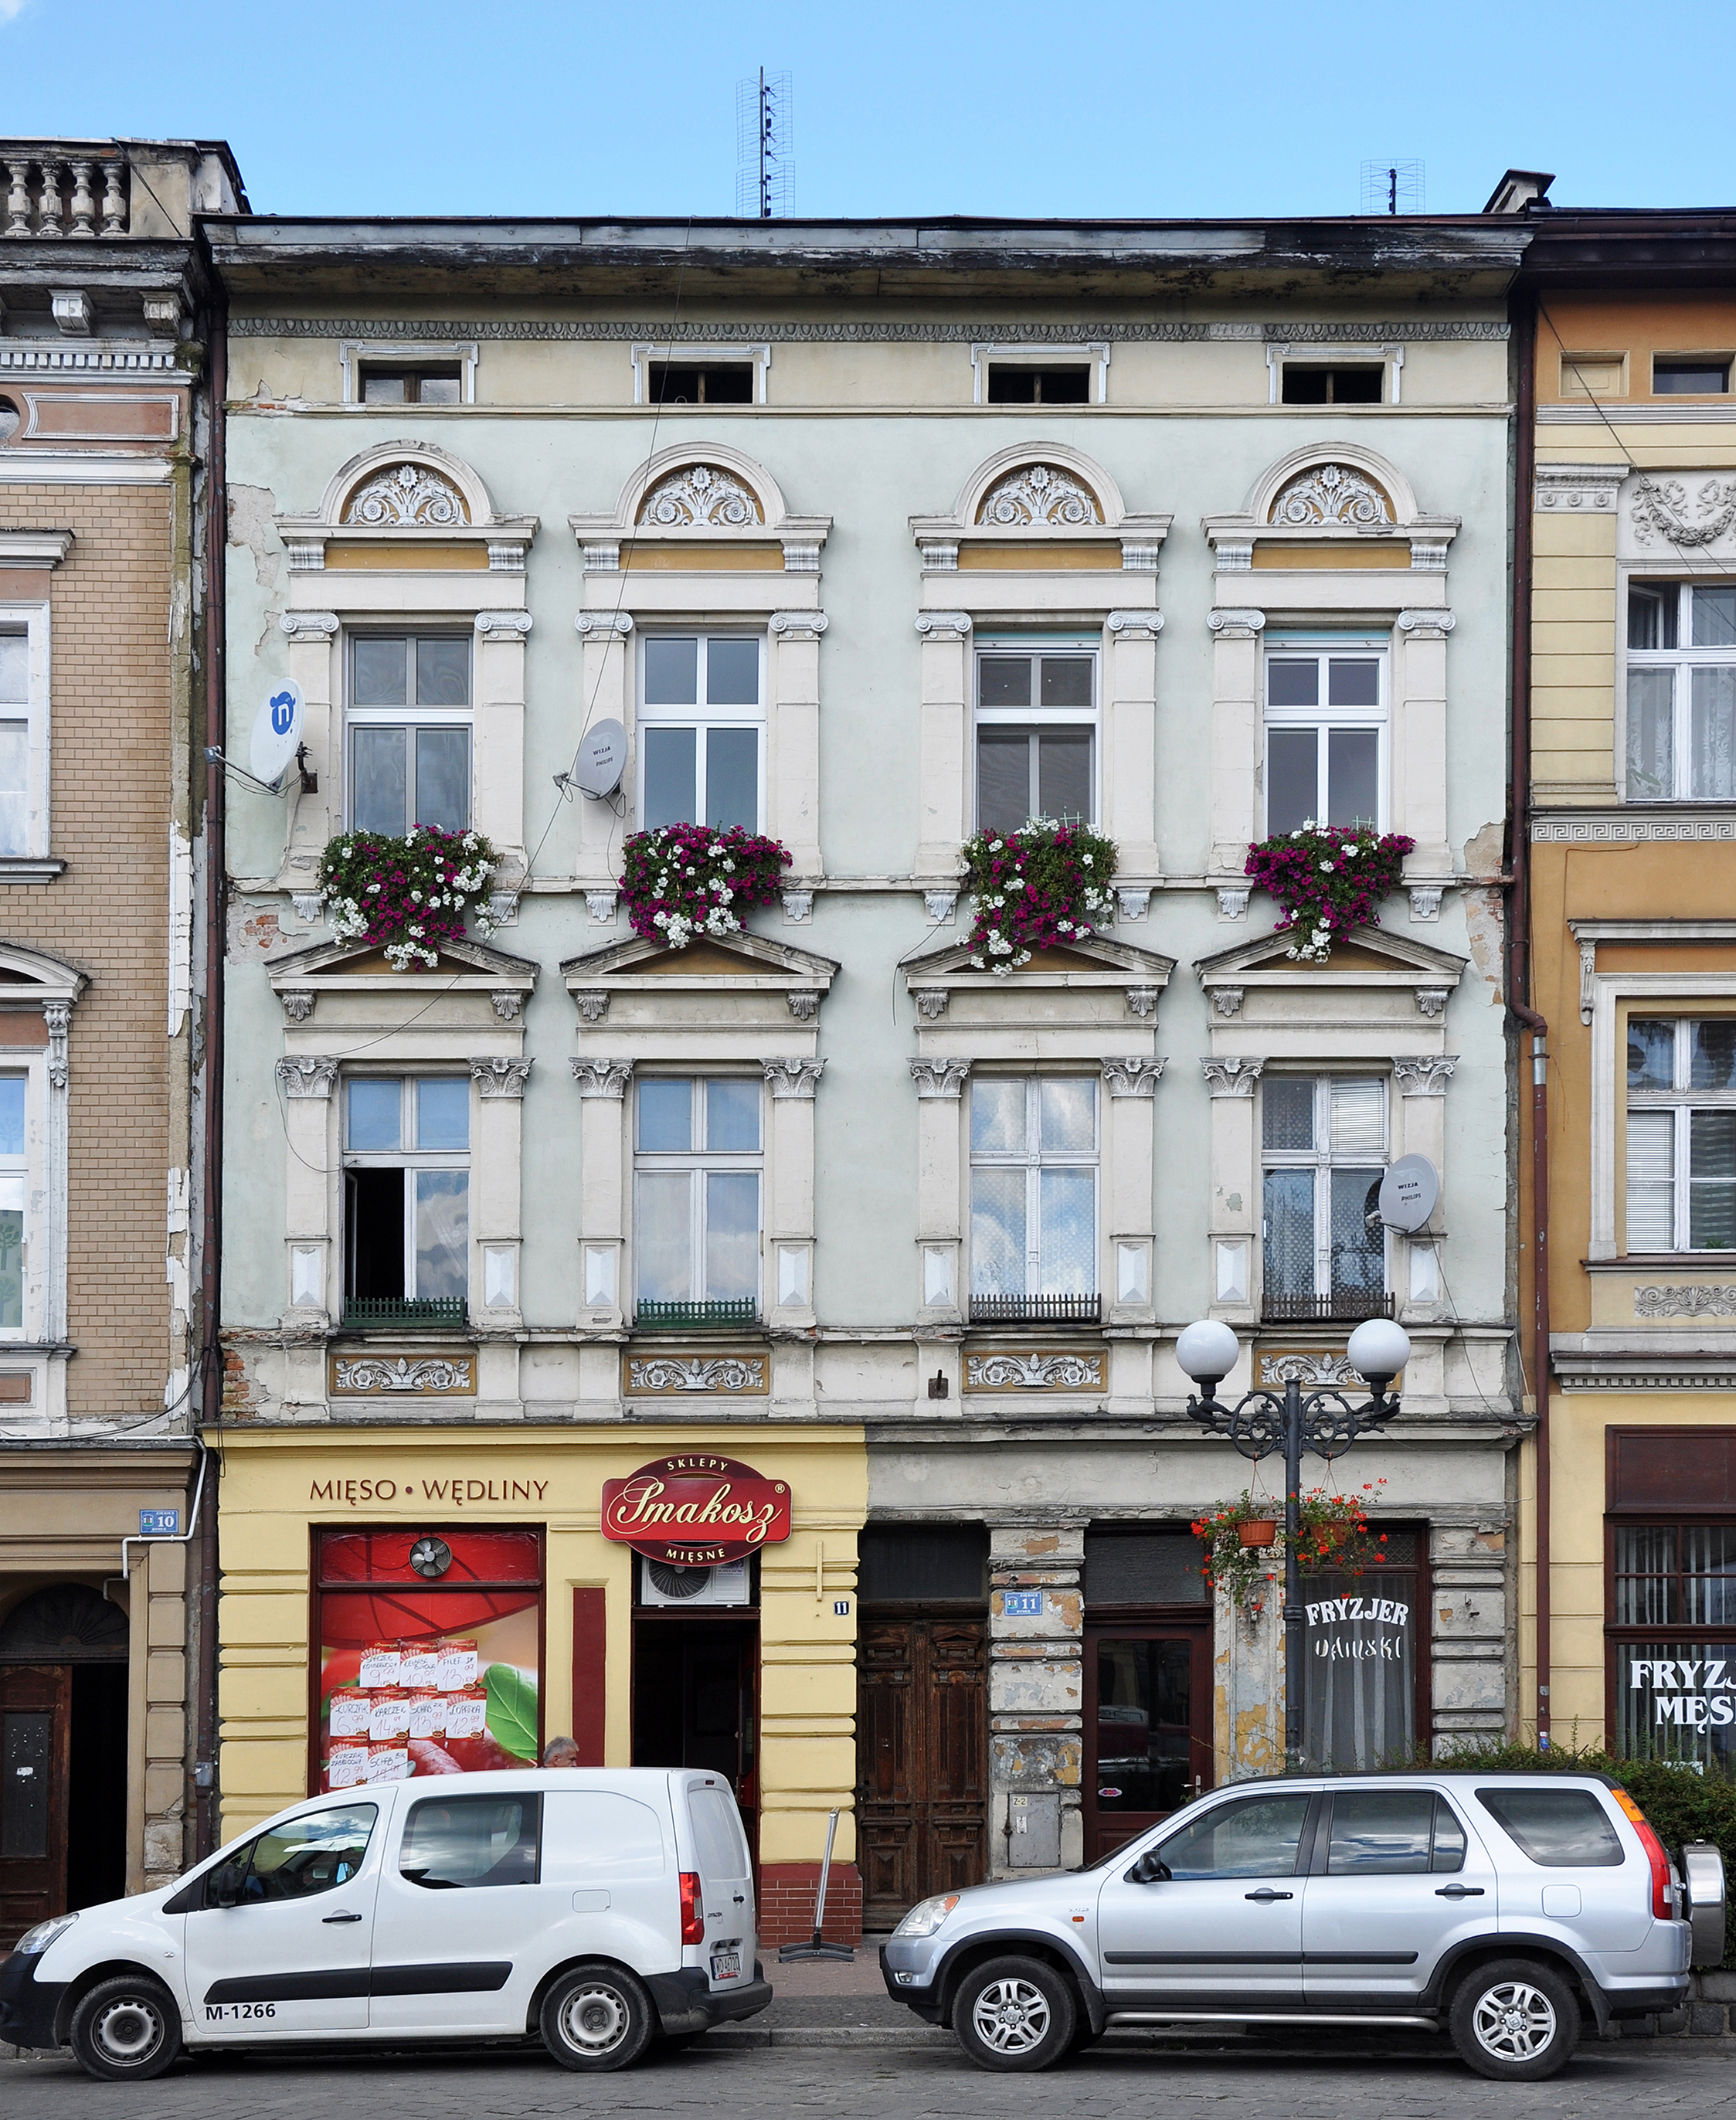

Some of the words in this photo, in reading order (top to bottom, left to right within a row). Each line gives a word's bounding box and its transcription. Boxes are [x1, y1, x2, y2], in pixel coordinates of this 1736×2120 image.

[667, 1458, 729, 1471] SKLEPY
[309, 1480, 397, 1505] MIĘSO
[421, 1480, 549, 1505] WĘDLINY
[606, 1476, 783, 1543] Smakosz
[158, 1516, 175, 1527] 10
[666, 1548, 725, 1563] MIĘSNE
[836, 1602, 847, 1614] 11
[1022, 1598, 1036, 1609] 11
[1305, 1597, 1408, 1626] FRYZJER
[443, 1657, 461, 1666] FILET
[369, 1669, 380, 1686] 9
[406, 1673, 423, 1686] 10
[443, 1668, 462, 1688] 13
[335, 1704, 369, 1714] KURCZAK
[375, 1706, 406, 1717] KARCZEK
[409, 1705, 433, 1714] SCHAB
[1655, 1696, 1736, 1734] MĘS
[337, 1716, 351, 1734] 6
[352, 1714, 364, 1723] 99
[375, 1719, 391, 1736] 14
[414, 1716, 431, 1732] 13
[433, 1711, 442, 1720] 99
[451, 1717, 467, 1734] 12
[370, 1757, 393, 1768] SCHAB
[334, 1768, 351, 1785] 12
[206, 2003, 276, 2020] M-1266
